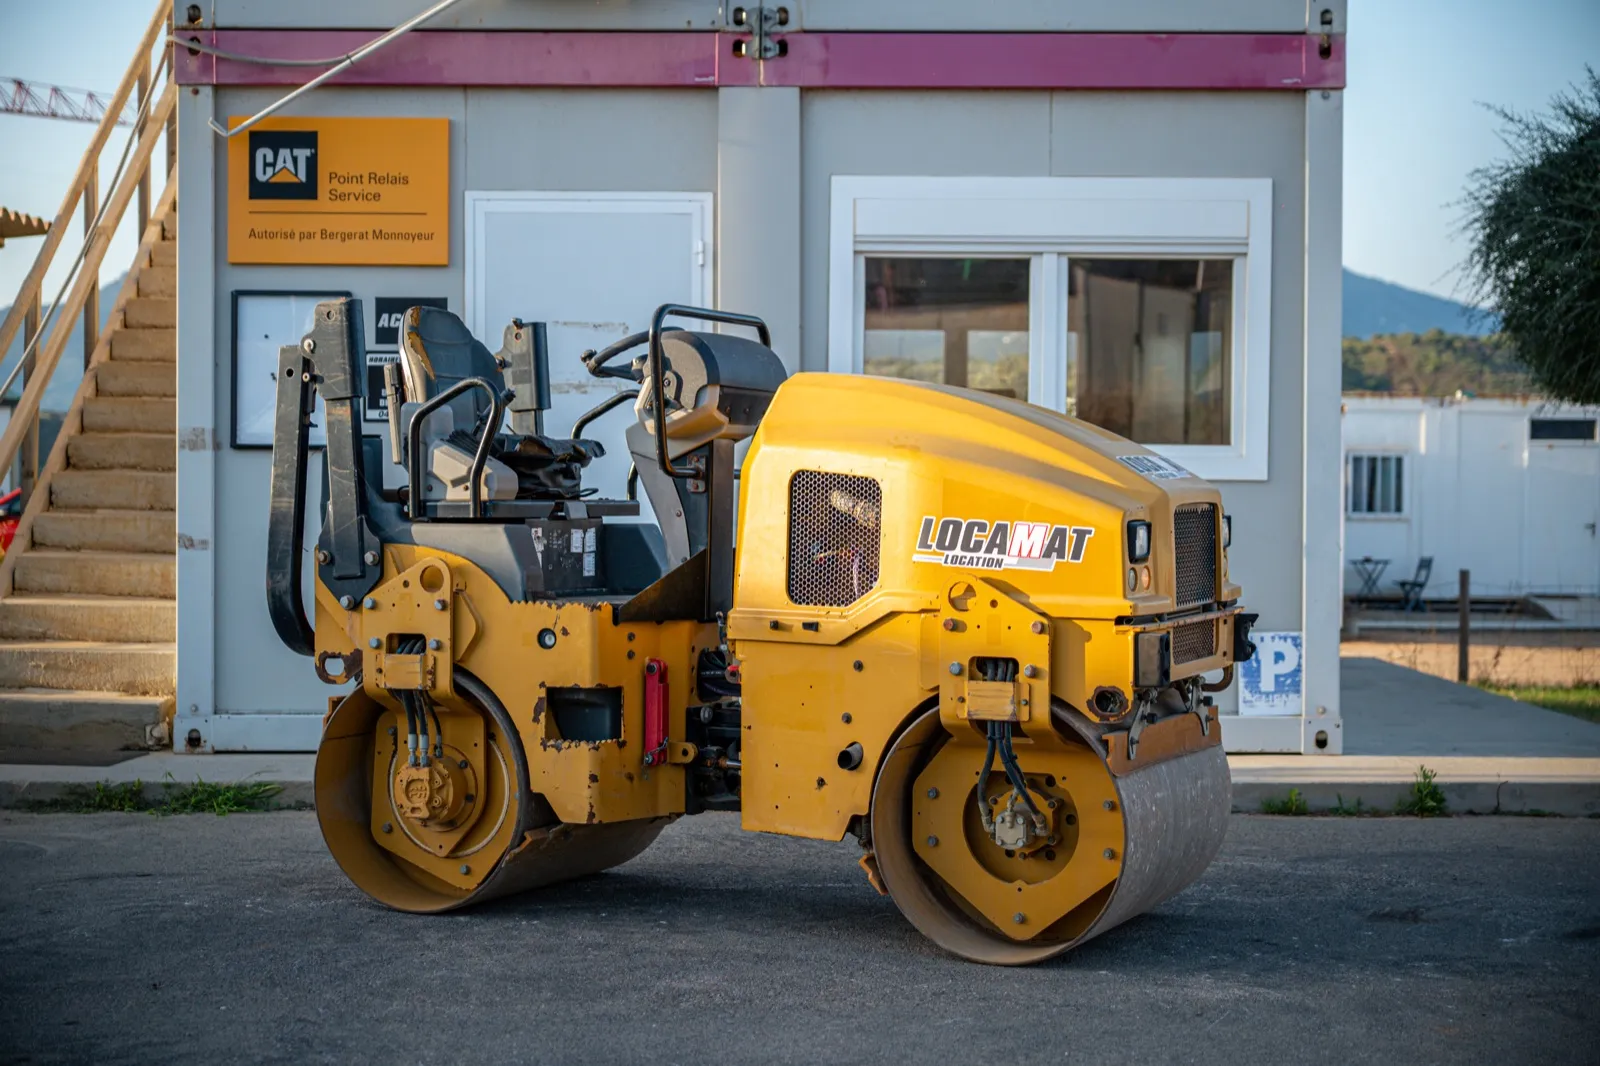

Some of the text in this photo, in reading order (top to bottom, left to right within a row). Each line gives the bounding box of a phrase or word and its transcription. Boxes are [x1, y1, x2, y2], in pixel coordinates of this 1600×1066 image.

[255, 147, 312, 183] CAT
[328, 171, 409, 185] Point Relais
[328, 188, 381, 202] Service
[248, 228, 435, 243] Autorisé par Bergerat Monnoyeur
[917, 517, 1093, 561] LOCAMAT
[943, 554, 1004, 569] LOCATION
[1260, 640, 1299, 692] P
